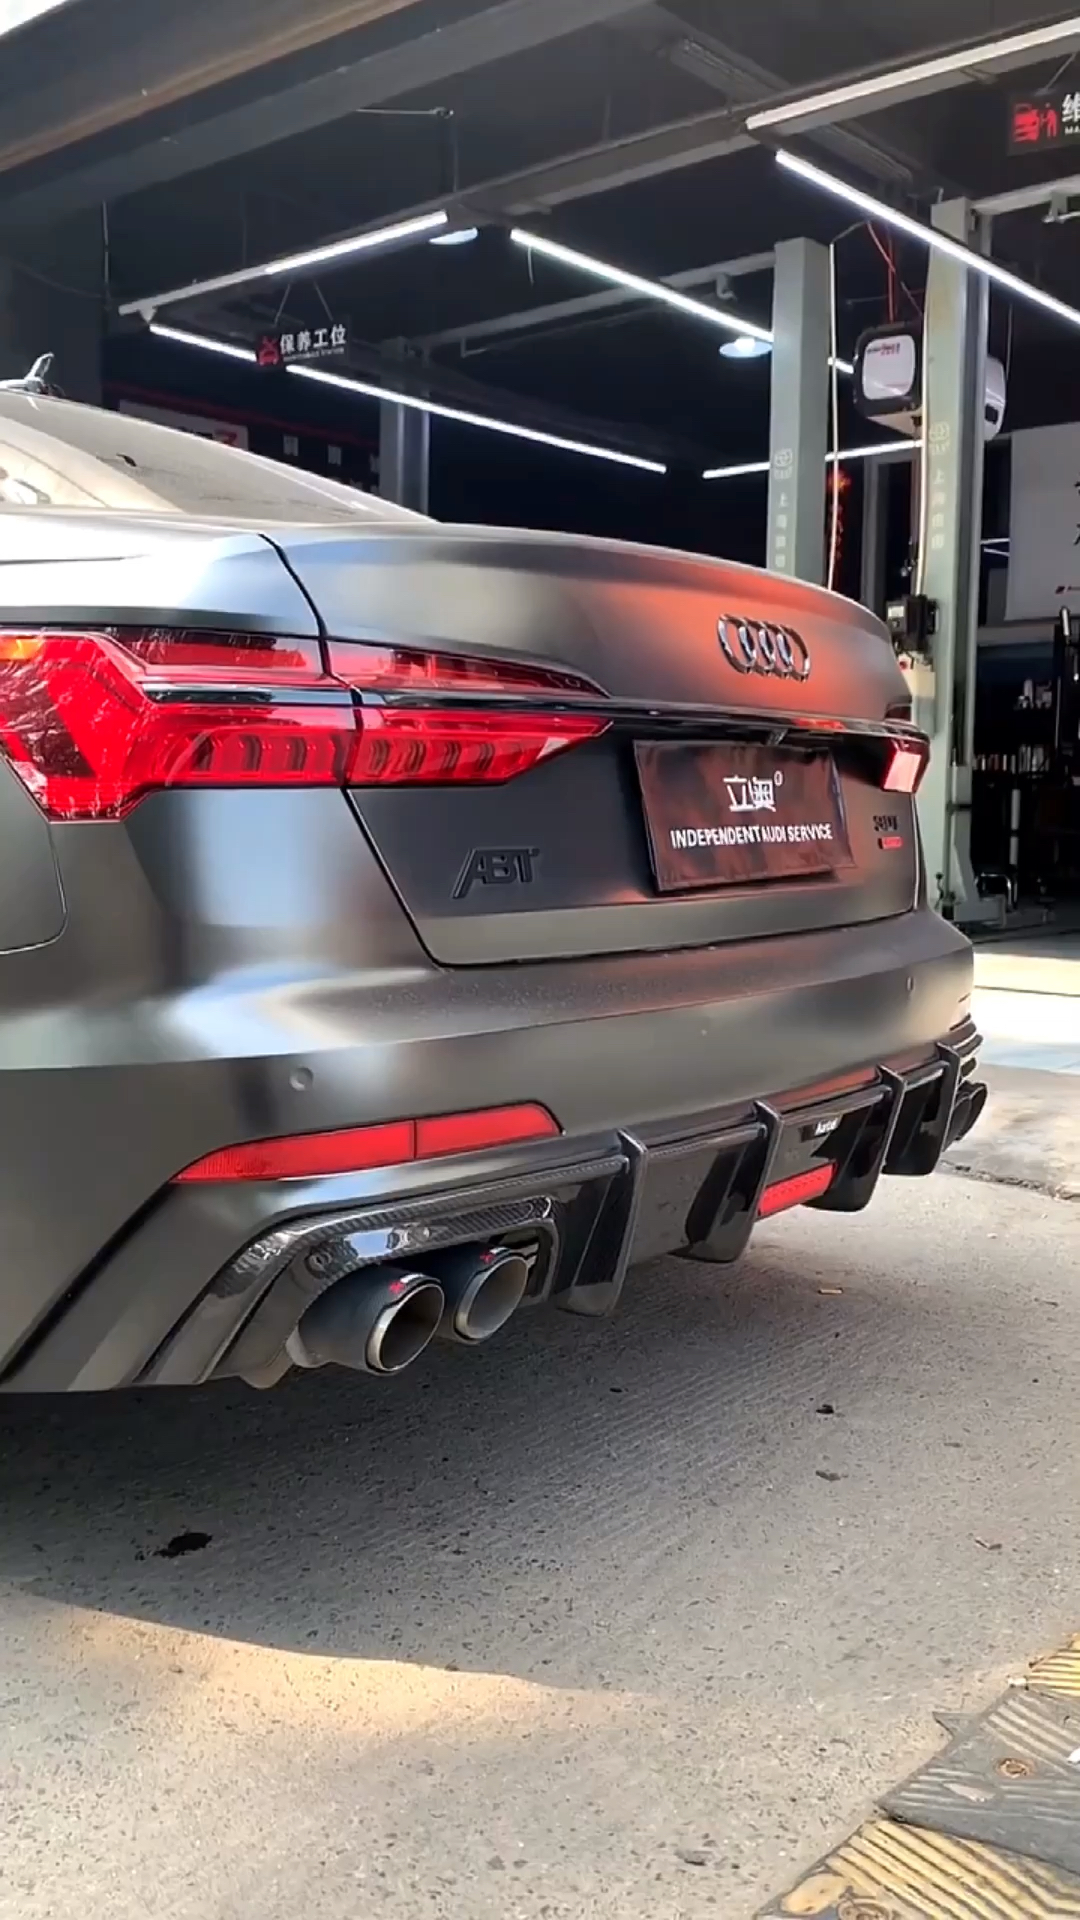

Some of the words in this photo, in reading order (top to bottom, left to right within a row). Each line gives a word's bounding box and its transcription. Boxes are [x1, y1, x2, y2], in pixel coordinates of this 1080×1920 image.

[280, 324, 346, 355] 保养工位
[670, 824, 761, 849] INDEPENDENT
[762, 825, 786, 843] AUDI
[788, 823, 833, 843] SERVICE
[451, 847, 540, 899] ABT
